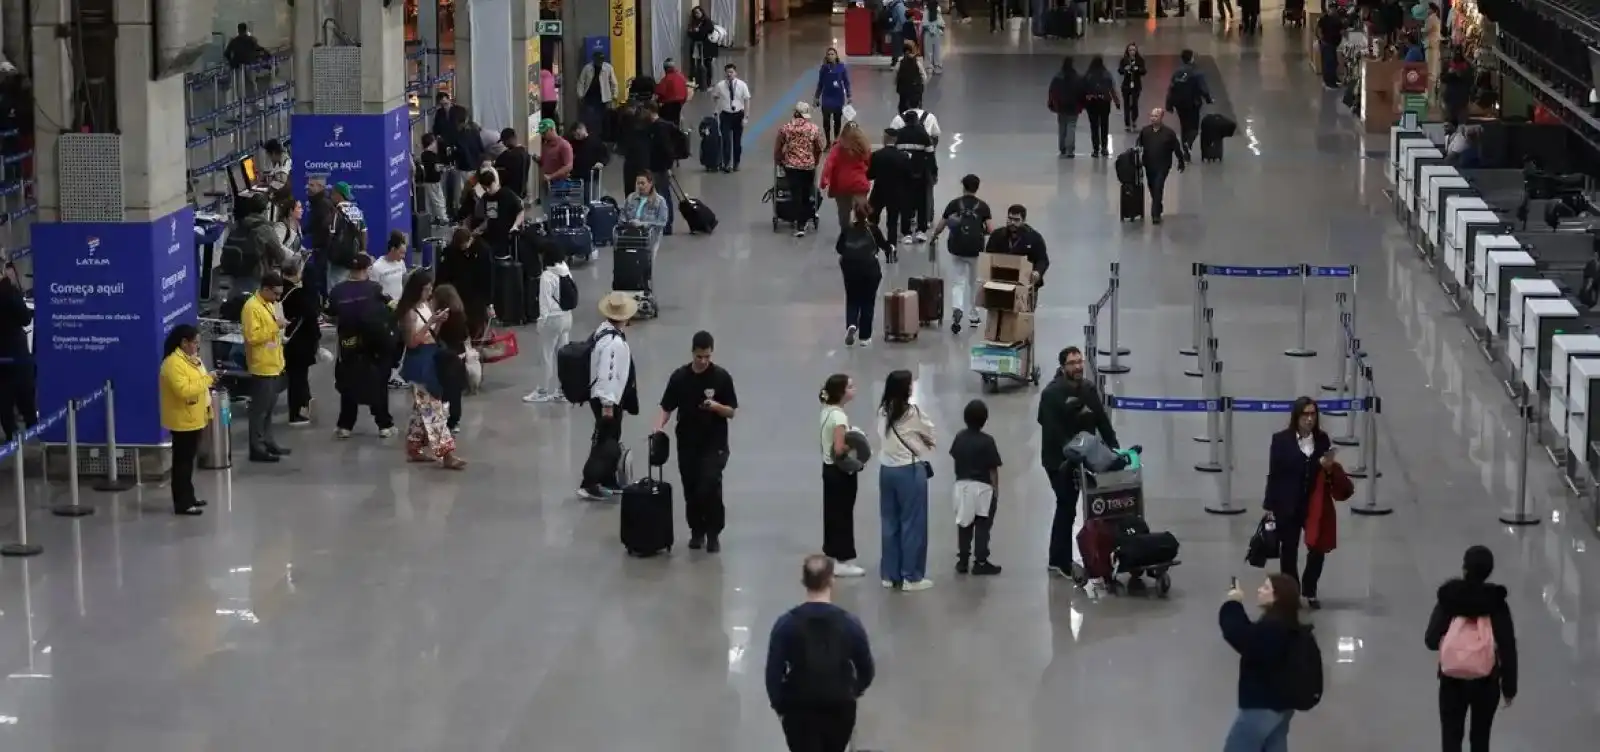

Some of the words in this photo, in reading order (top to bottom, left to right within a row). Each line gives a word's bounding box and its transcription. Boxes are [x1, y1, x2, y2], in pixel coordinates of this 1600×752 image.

[304, 160, 339, 171] Começa
[341, 160, 362, 172] aqui!
[76, 258, 110, 266] LATAM
[50, 283, 94, 296] Começa
[96, 282, 124, 296] aqui!
